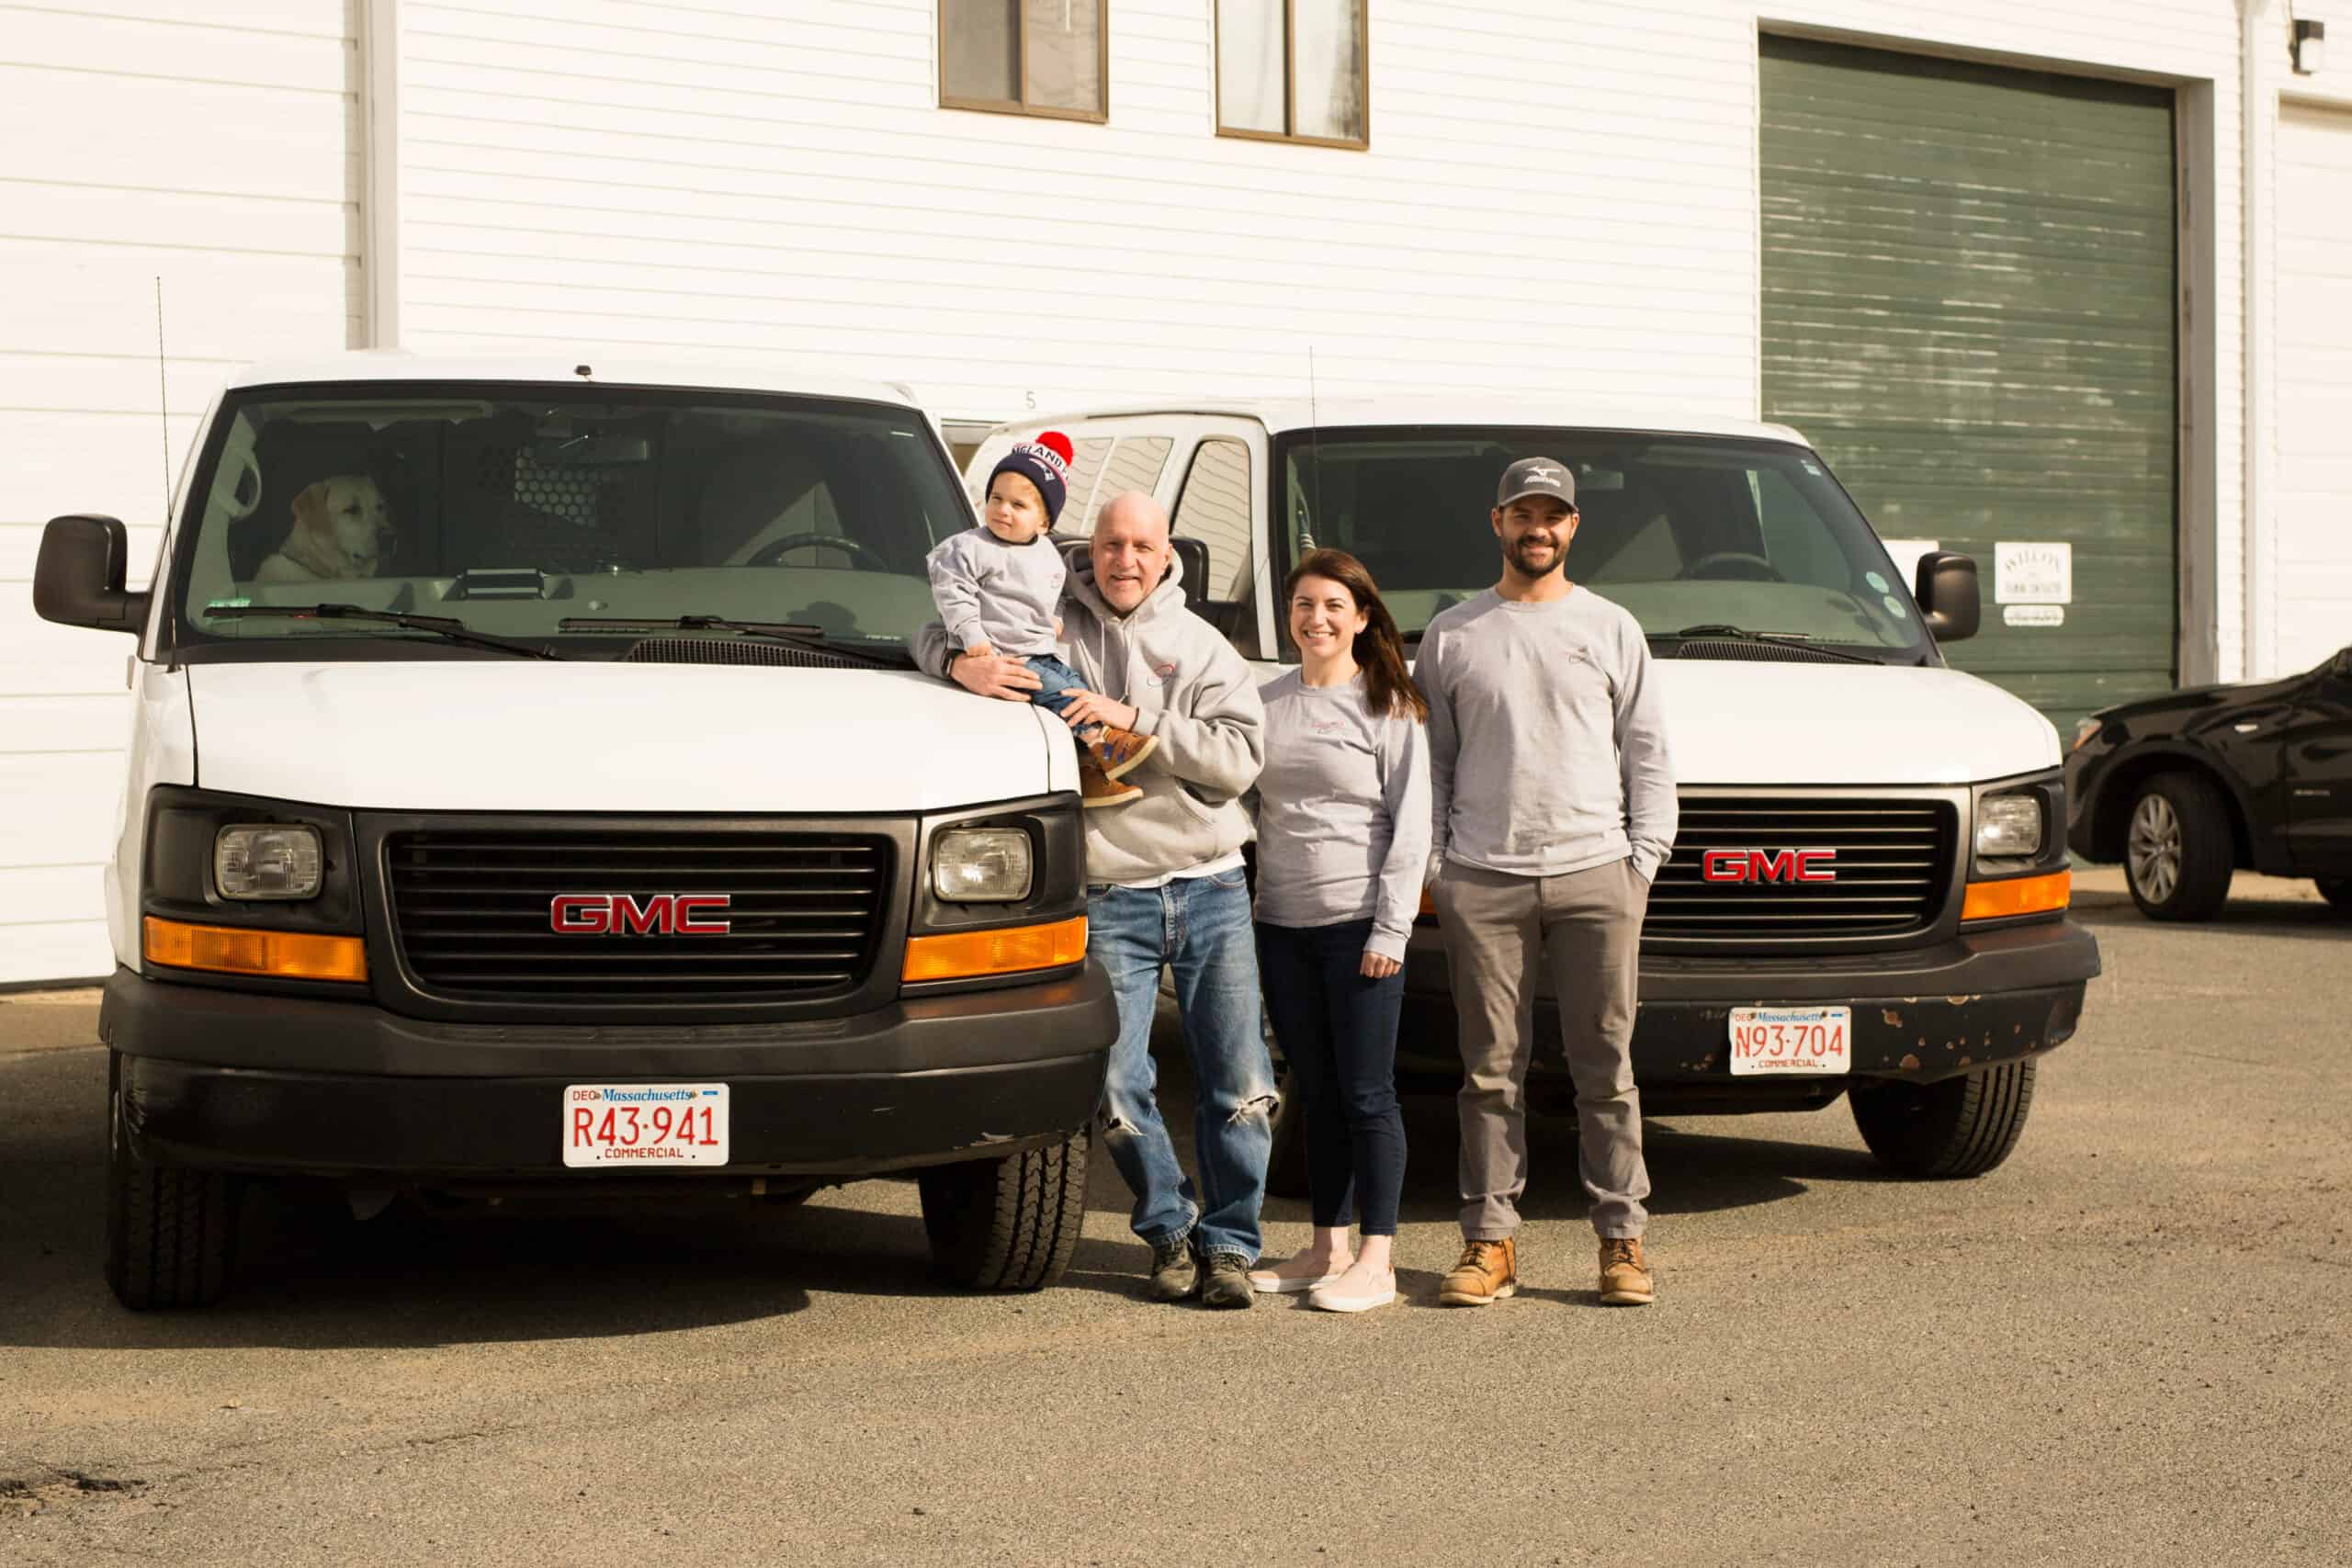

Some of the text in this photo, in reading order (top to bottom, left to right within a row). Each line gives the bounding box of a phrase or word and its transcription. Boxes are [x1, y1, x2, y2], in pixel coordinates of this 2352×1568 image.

[1026, 390, 1036, 410] 5
[1703, 849, 1837, 882] GMC
[551, 894, 730, 934] GMC
[1757, 1011, 1824, 1022] Massachusetts
[1758, 1058, 1818, 1068] COMMERCIAL
[602, 1088, 692, 1101] Massachusetts
[605, 1147, 684, 1158] COMMERCIAL
